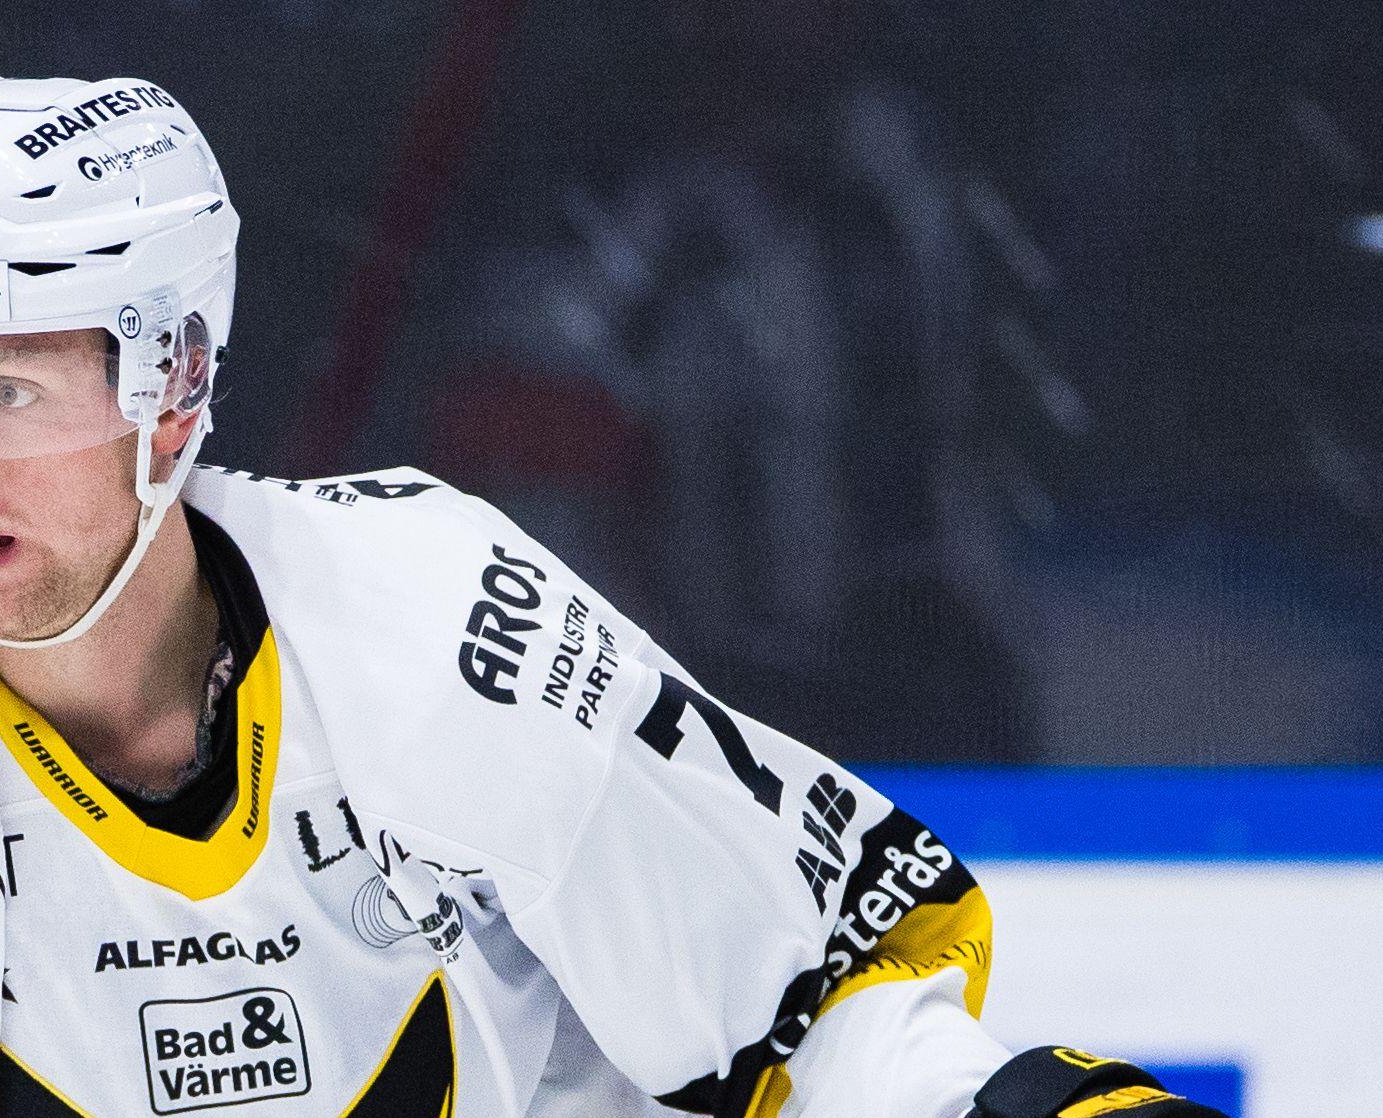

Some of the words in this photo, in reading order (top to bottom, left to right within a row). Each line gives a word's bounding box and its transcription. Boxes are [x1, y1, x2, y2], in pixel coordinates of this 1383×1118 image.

[541, 595, 590, 709] INDUSTRI
[13, 722, 109, 822] WARRIOR
[242, 721, 265, 839] WARRIOR
[633, 671, 784, 818] 7
[154, 1022, 235, 1061] Bad
[241, 996, 294, 1049] &
[159, 1057, 297, 1101] Värme
